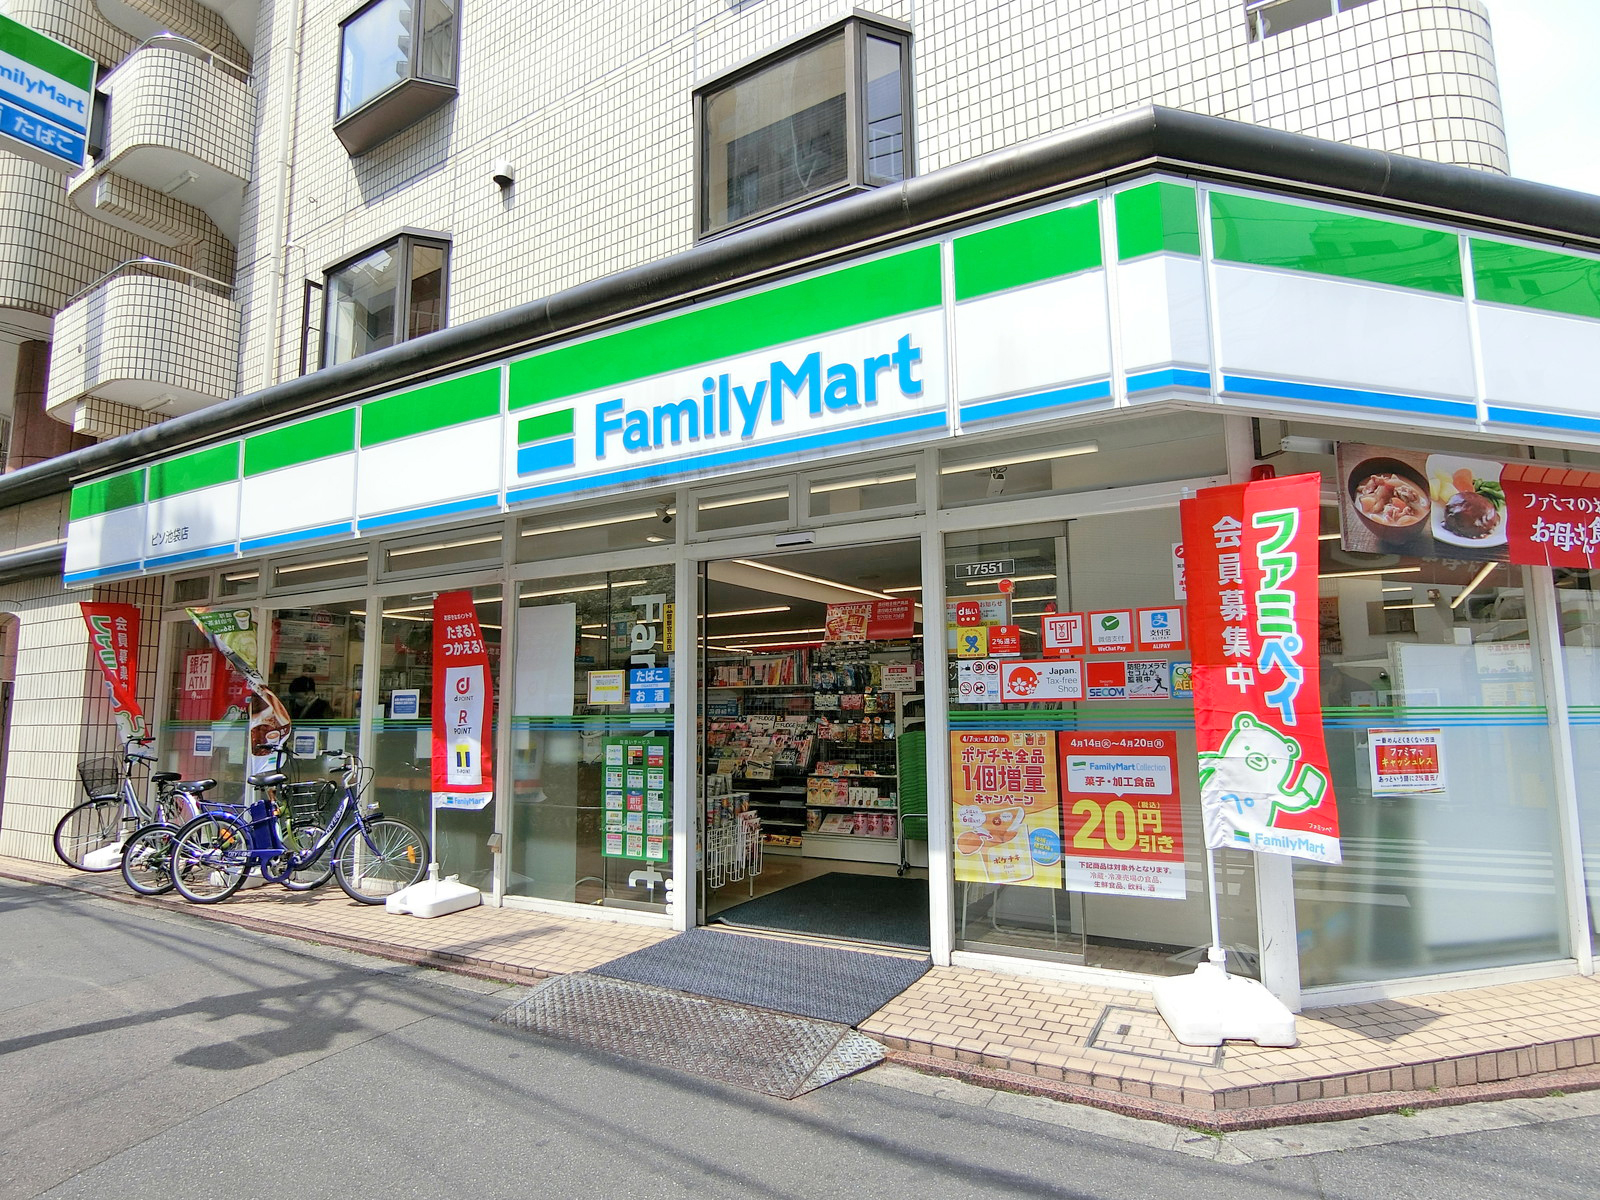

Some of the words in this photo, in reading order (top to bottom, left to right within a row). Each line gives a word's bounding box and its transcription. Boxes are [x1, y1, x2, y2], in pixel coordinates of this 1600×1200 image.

[13, 116, 73, 155] たばこ
[595, 333, 924, 460] FamilyMart
[965, 562, 1003, 576] 17551
[1212, 515, 1255, 694] 会員募集中
[958, 606, 978, 616] d払い
[1252, 507, 1304, 726] ファミペイ
[446, 622, 477, 639] たまる!
[442, 639, 485, 656] つかえる!
[189, 655, 210, 674] 銀行
[1127, 662, 1167, 670] 防犯カメラで
[636, 670, 664, 682] たばこ
[1048, 667, 1077, 676] Japan.
[188, 676, 208, 690] ATM
[1046, 676, 1078, 685] Tax-free
[1127, 675, 1151, 683] 監視中
[1057, 684, 1078, 694] Shop
[1089, 687, 1125, 697] SECOM
[635, 690, 665, 702] お酒
[454, 727, 472, 735] POINT
[961, 745, 1046, 764] ポケチキ全品
[1389, 747, 1424, 757] ファミマで
[1089, 762, 1135, 772] FamilyMart
[1135, 762, 1167, 772] Collection
[1381, 757, 1434, 768] キャッシュレス
[962, 765, 1046, 792] 1個増量
[1084, 776, 1156, 788] 菓子・加工食品
[454, 797, 485, 806] FamilyMart
[975, 793, 1034, 805] キャンペーン
[1255, 832, 1326, 855] FamilyMart
[1078, 861, 1172, 875] 下記商品は対象外となります。
